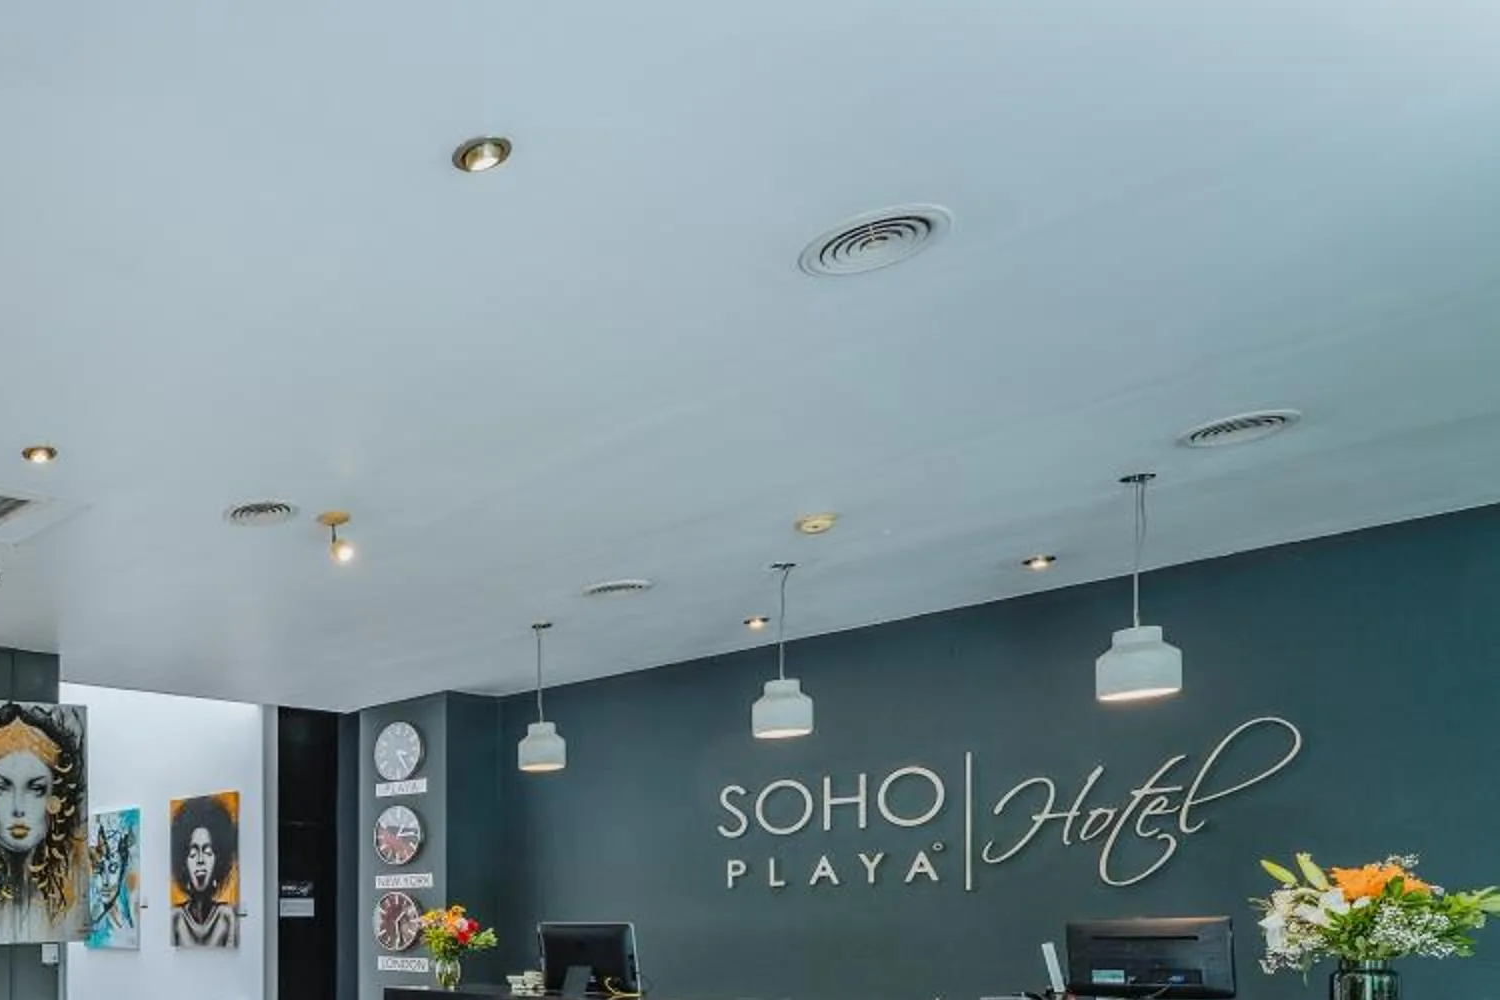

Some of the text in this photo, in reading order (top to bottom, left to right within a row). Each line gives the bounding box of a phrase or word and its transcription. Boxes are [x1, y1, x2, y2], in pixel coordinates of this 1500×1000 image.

[718, 716, 1301, 887] SOHO Hotel
[726, 848, 941, 889] PLAYA
[381, 957, 426, 970] LONDON
